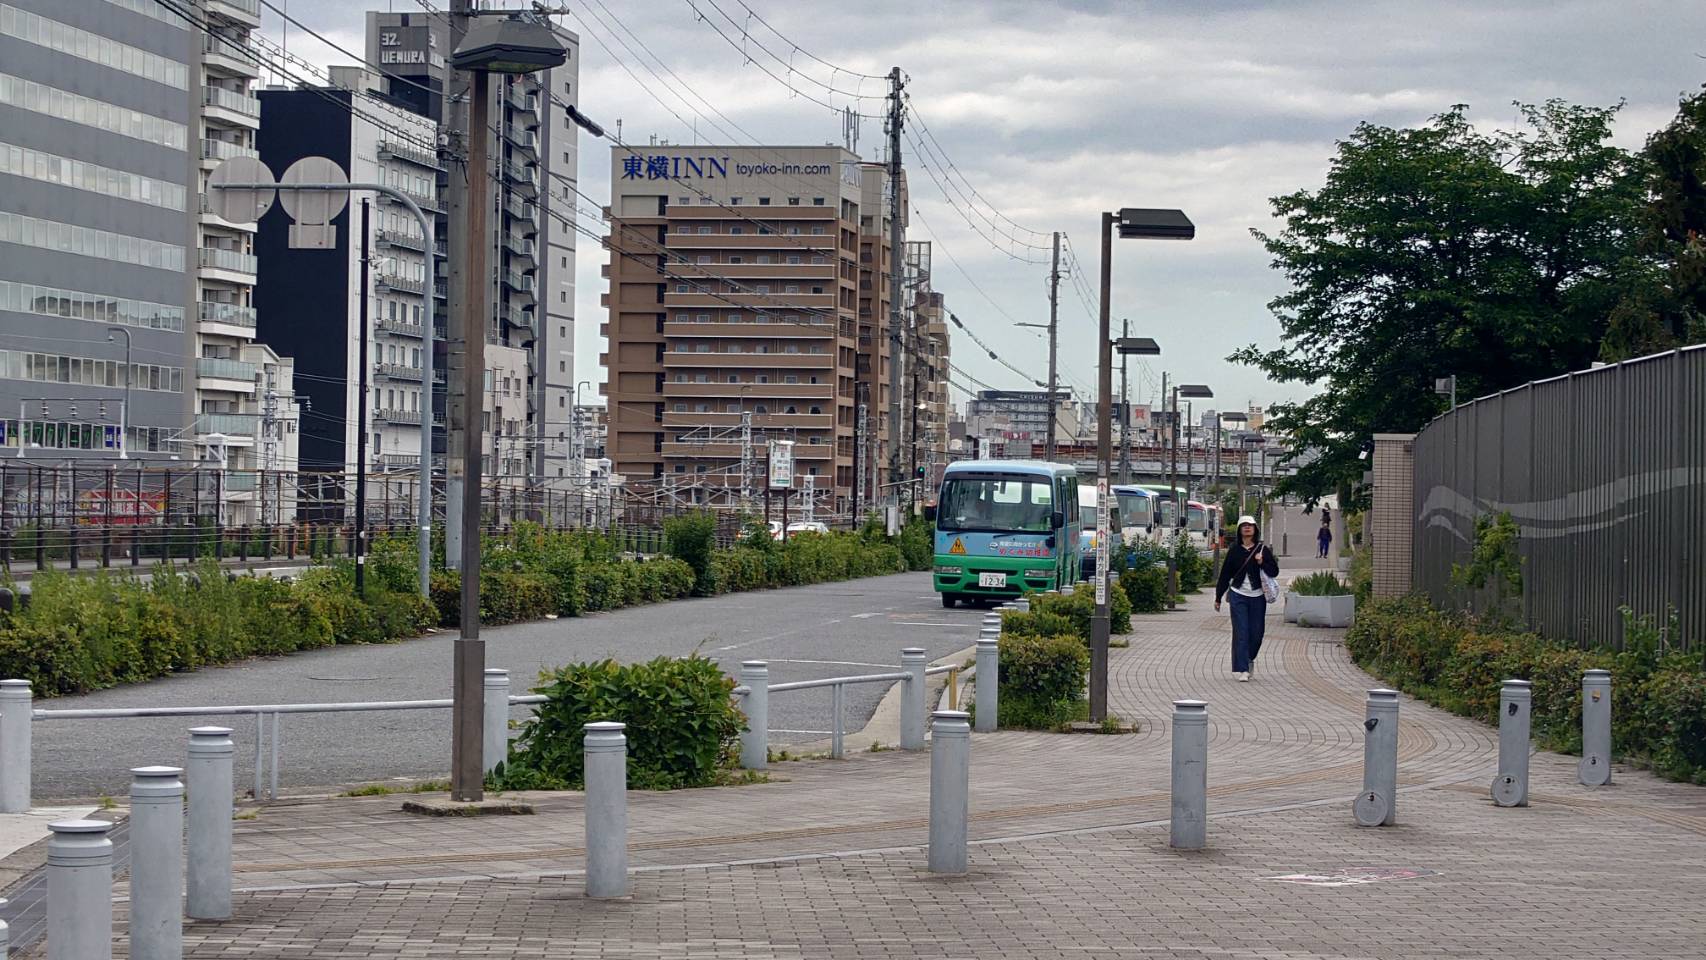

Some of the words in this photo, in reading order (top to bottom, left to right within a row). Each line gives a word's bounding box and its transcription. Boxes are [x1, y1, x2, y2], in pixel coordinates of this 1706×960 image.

[381, 50, 426, 64] UEMURA
[621, 155, 729, 180] 東横INN
[736, 162, 831, 177] toyoko-inn.com
